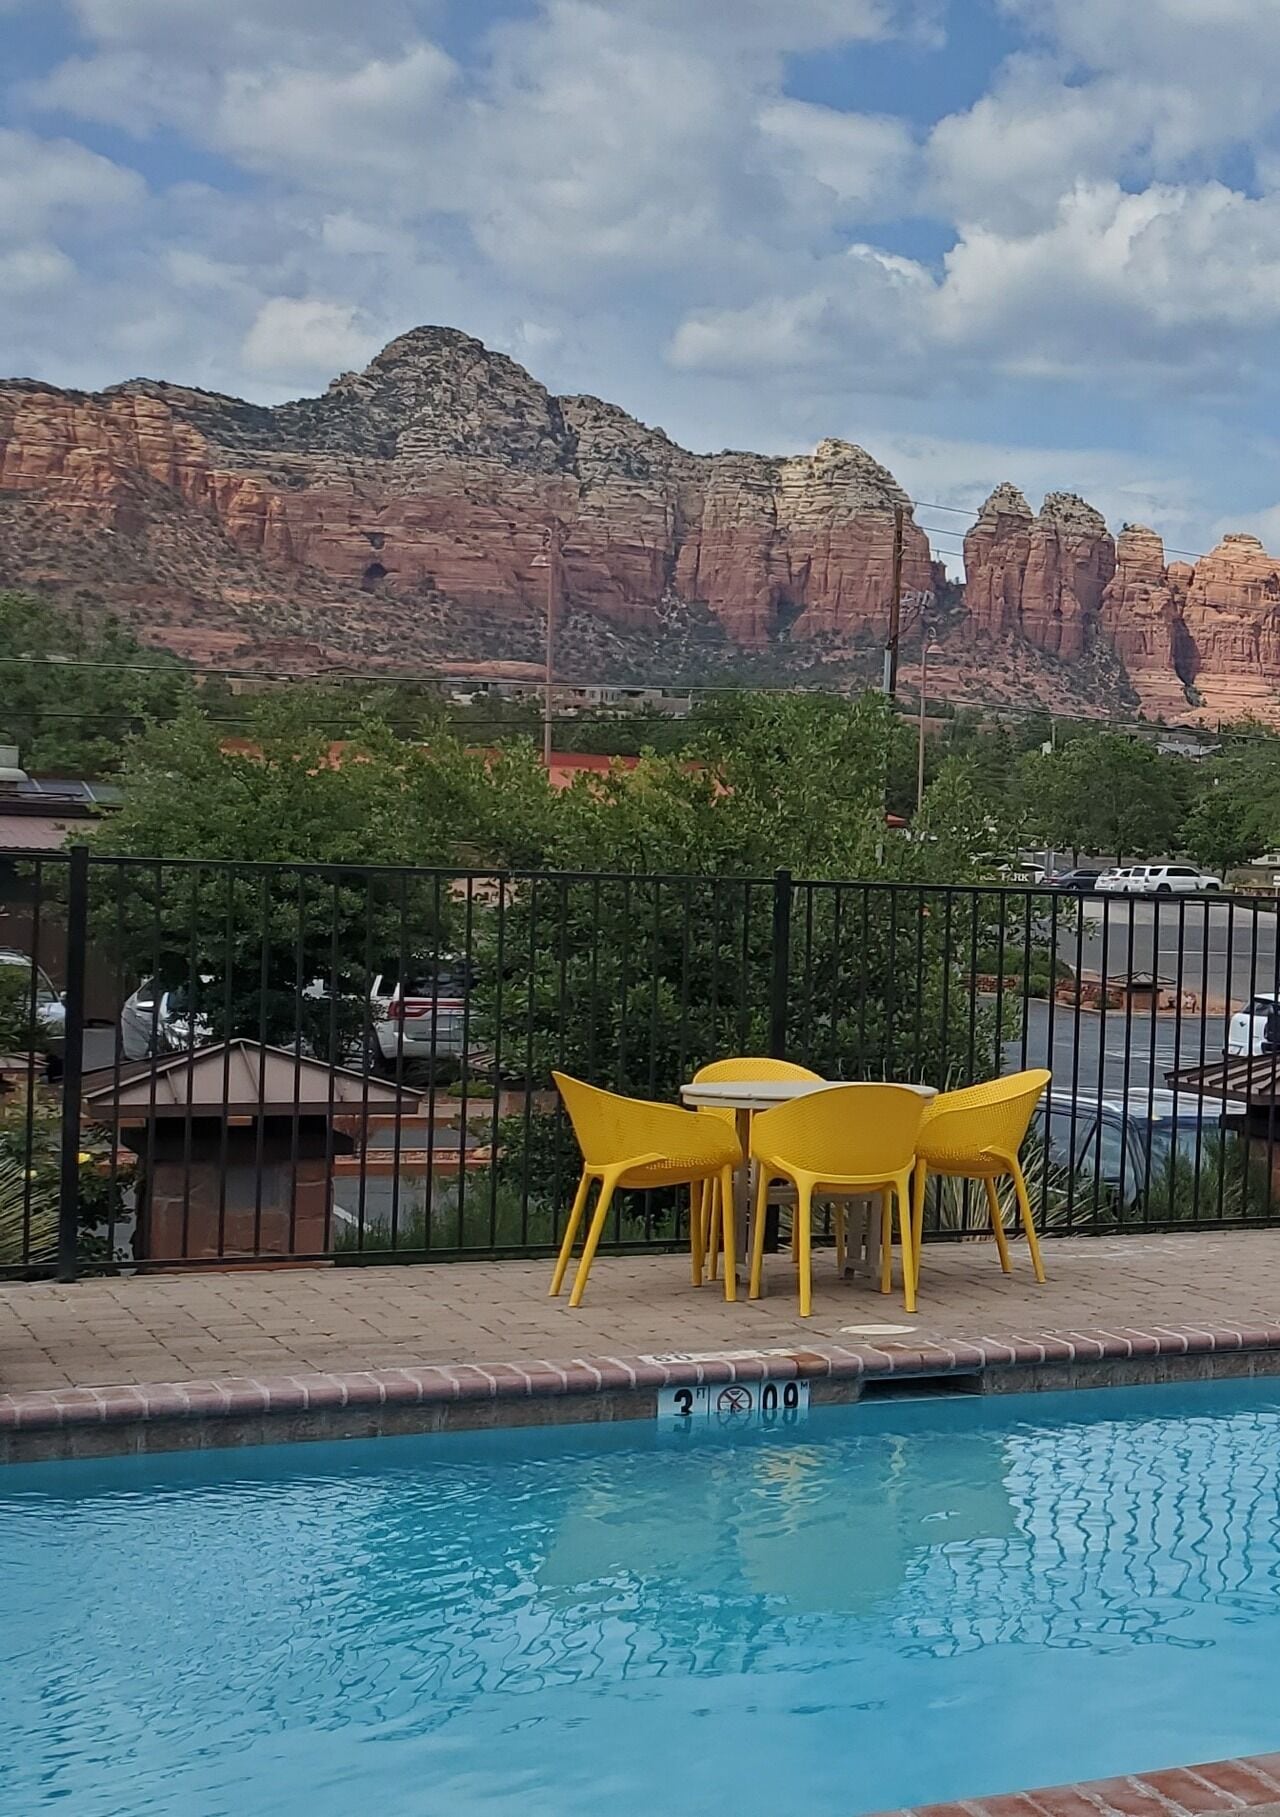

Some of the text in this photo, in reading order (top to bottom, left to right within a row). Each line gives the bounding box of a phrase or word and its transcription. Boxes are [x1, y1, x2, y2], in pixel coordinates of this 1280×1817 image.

[673, 1388, 694, 1416] 3
[696, 1387, 707, 1399] FT
[800, 1381, 808, 1390] M
